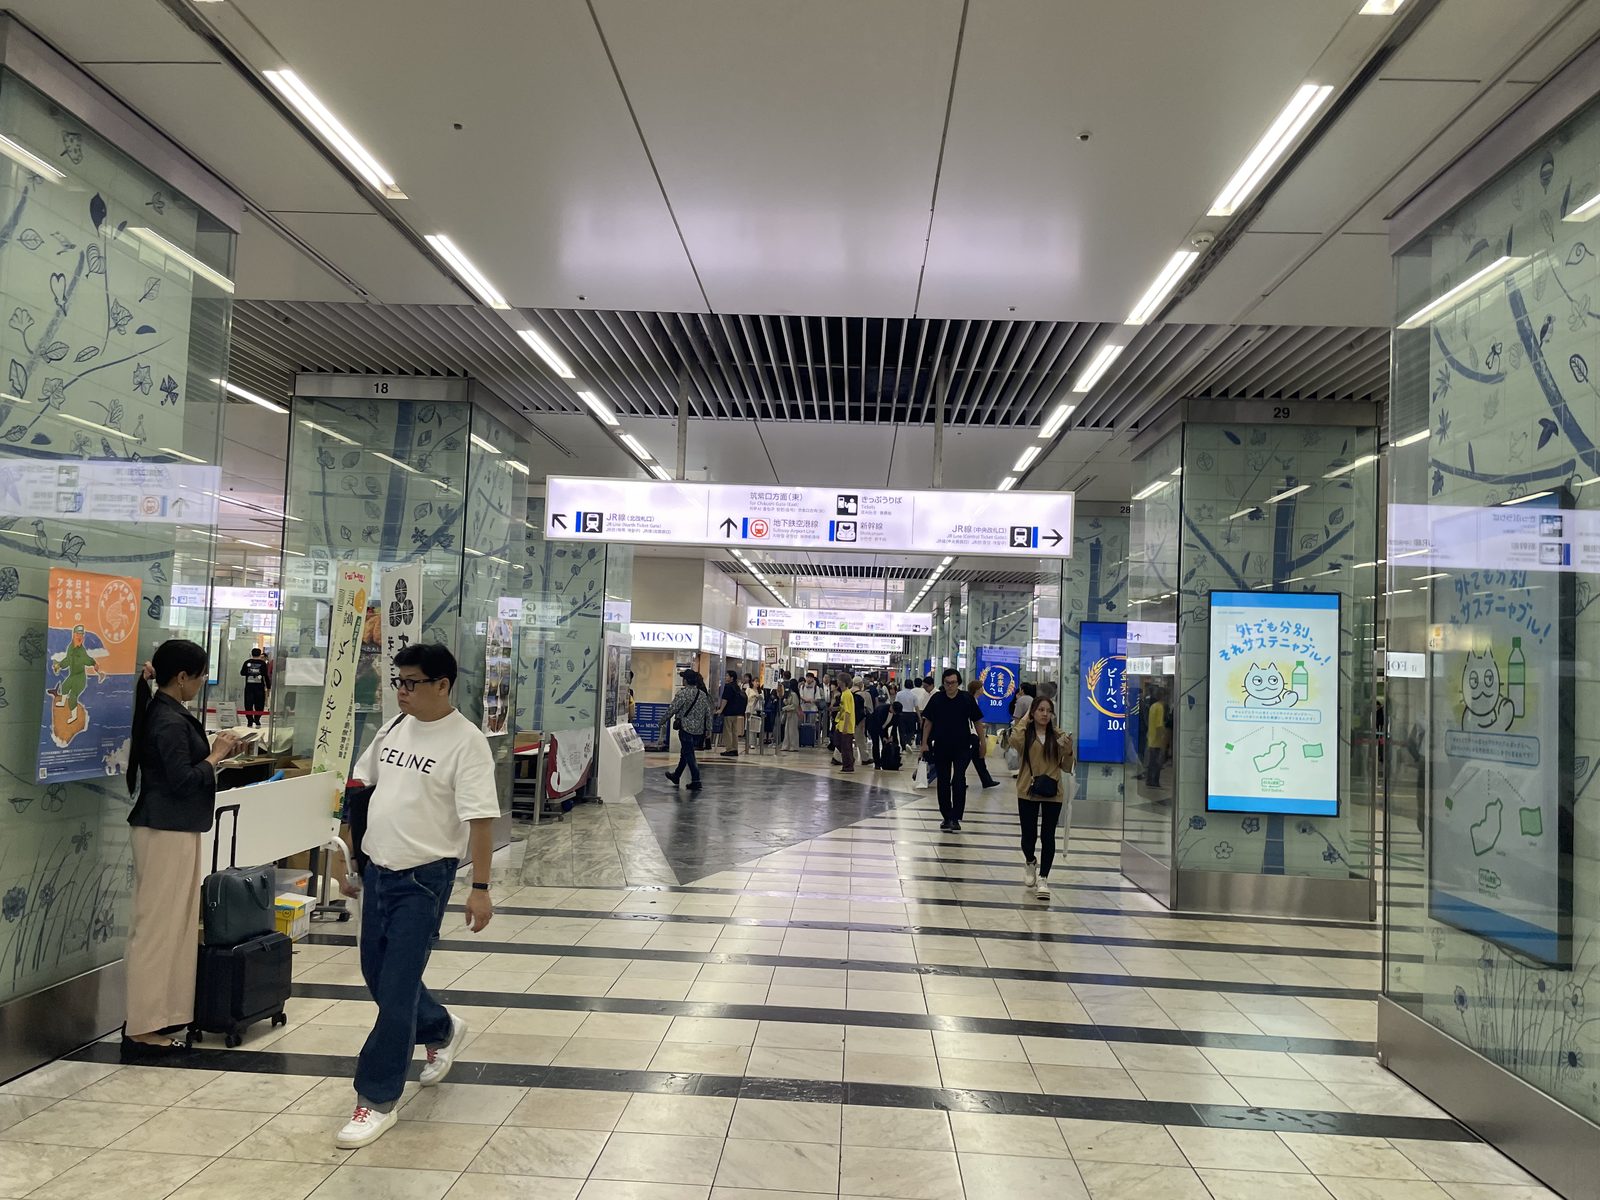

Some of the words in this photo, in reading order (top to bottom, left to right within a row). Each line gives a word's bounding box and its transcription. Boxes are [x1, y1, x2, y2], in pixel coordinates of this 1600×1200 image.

[374, 382, 389, 394] 18
[1273, 407, 1291, 419] 29
[1120, 506, 1131, 514] 28
[773, 519, 819, 528] 地下鉄空港線
[860, 522, 883, 530] 新幹線
[1235, 618, 1313, 641] 外でも分別、
[640, 631, 693, 643] MIGNON
[1219, 636, 1331, 666] それサステニャブル!
[1106, 668, 1118, 709] ビールへ。
[990, 699, 1003, 707] 10.6
[380, 747, 436, 774] CELINE
